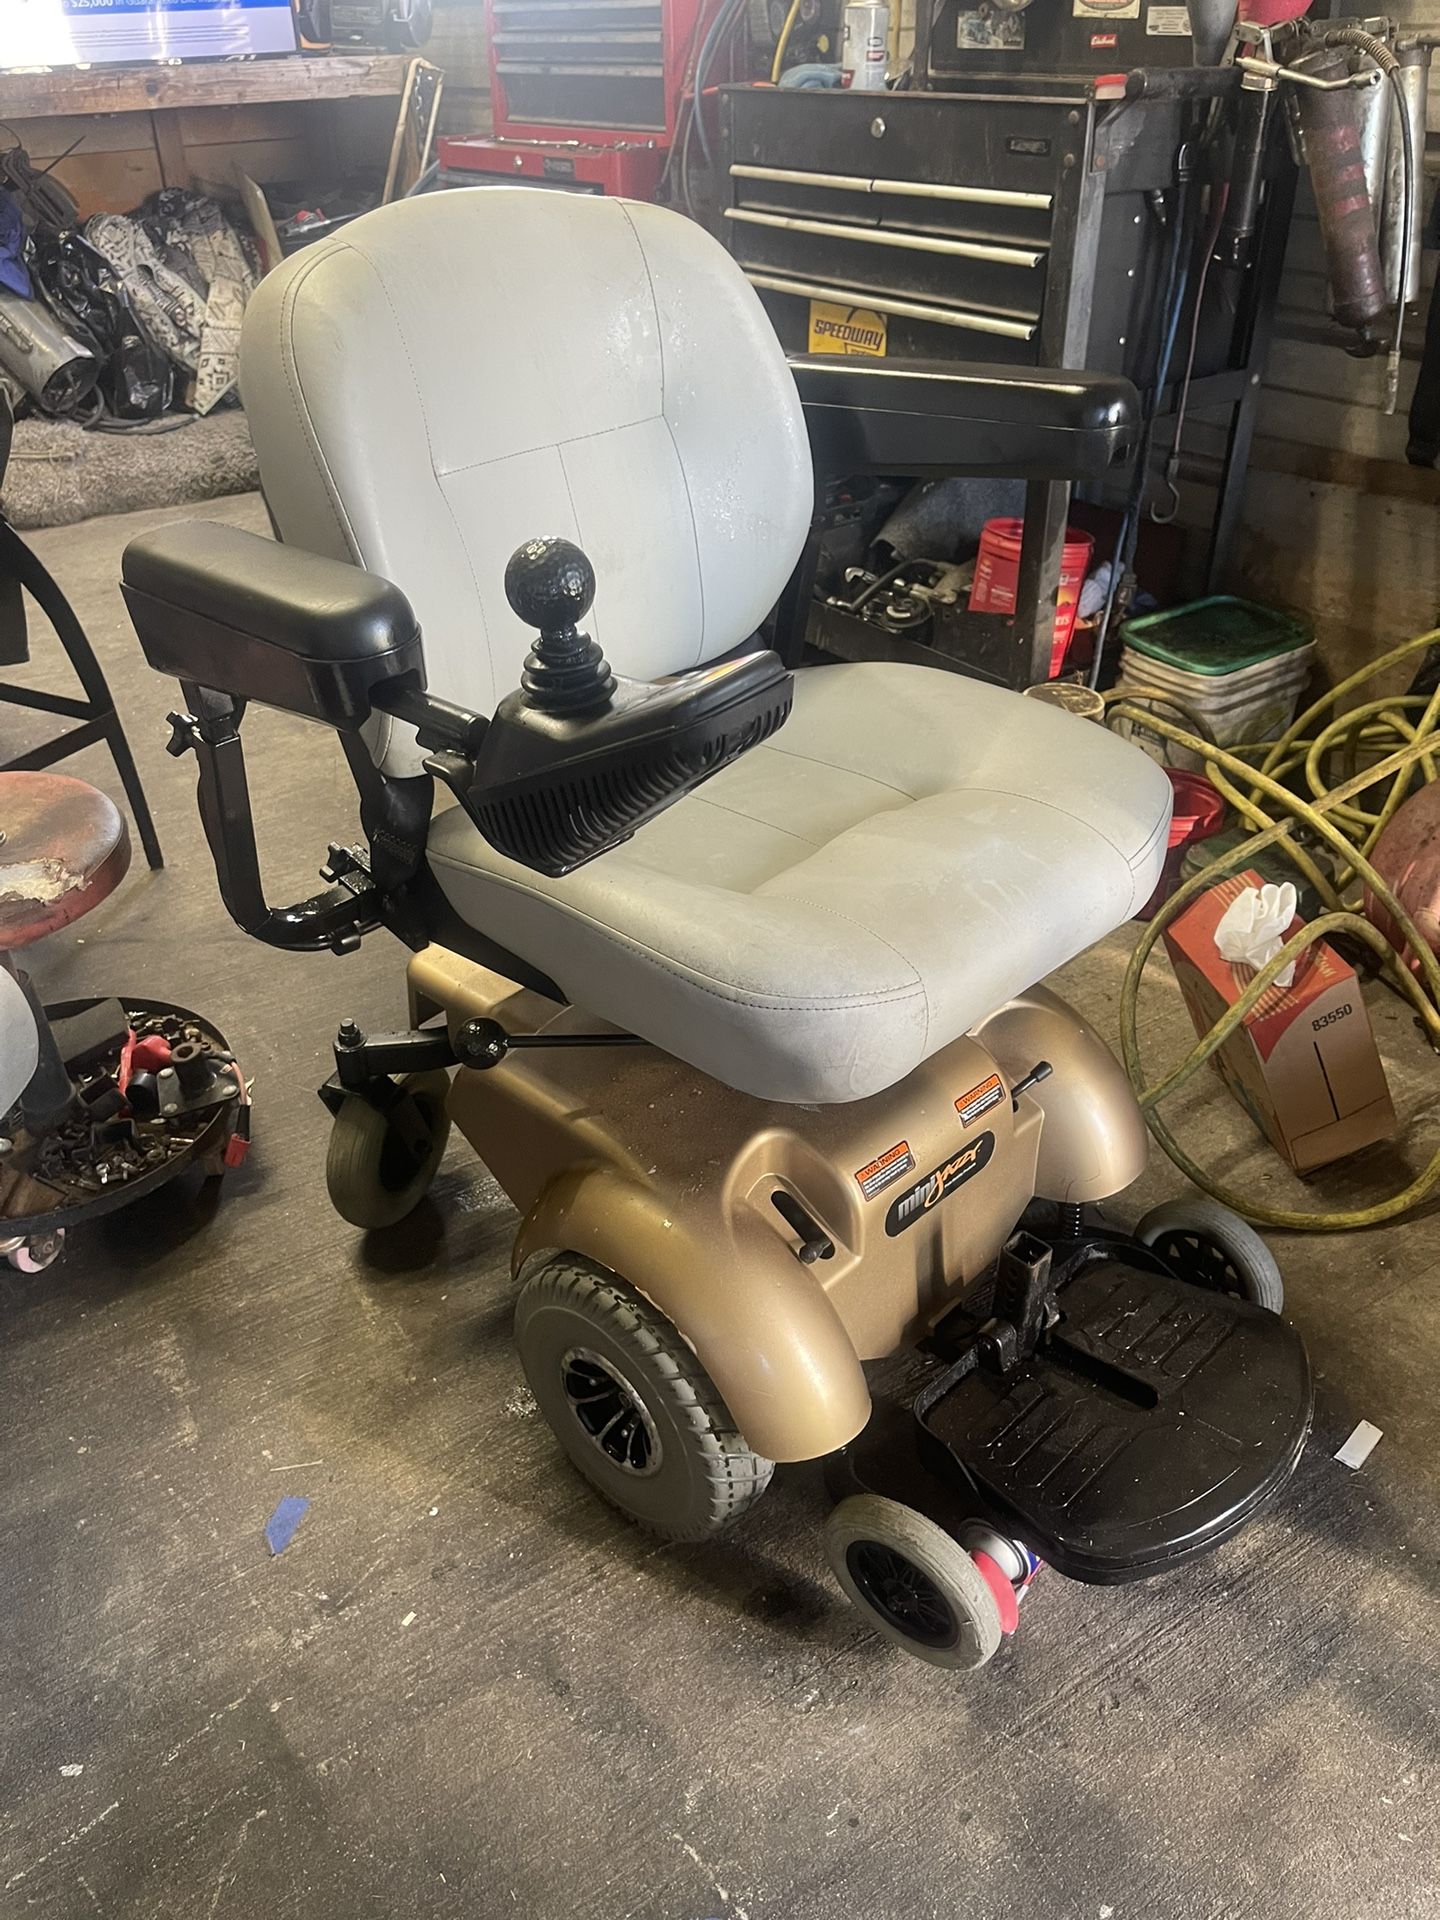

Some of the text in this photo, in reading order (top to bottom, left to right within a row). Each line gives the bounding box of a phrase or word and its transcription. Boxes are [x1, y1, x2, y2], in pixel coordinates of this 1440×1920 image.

[71, 0, 113, 8] $25,000
[814, 318, 884, 350] SPEEDWAY
[1311, 1003, 1353, 1032] 83550
[962, 1081, 993, 1104] WARNING
